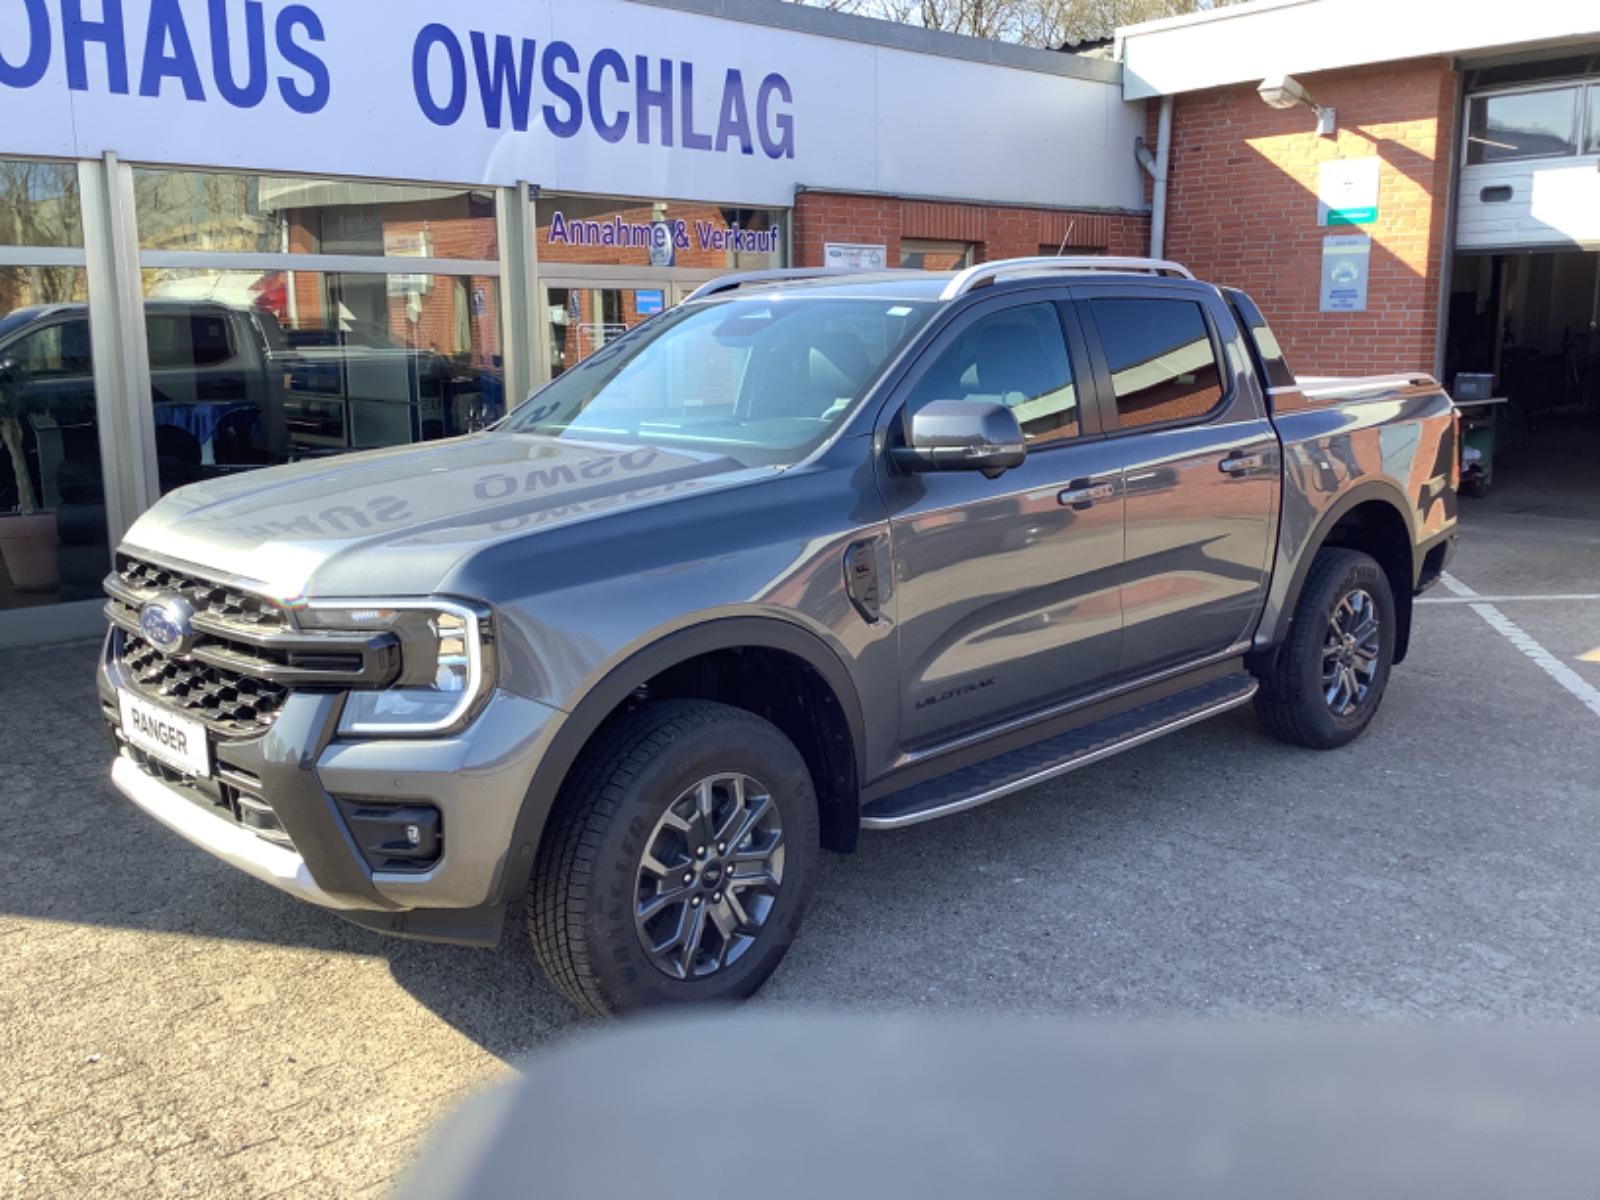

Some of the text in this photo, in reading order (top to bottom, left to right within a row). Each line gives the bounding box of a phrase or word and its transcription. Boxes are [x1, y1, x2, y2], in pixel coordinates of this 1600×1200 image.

[412, 22, 796, 160] OWSCHLAG
[549, 211, 779, 251] Annahme & Verkauf
[131, 708, 188, 754] RANGER
